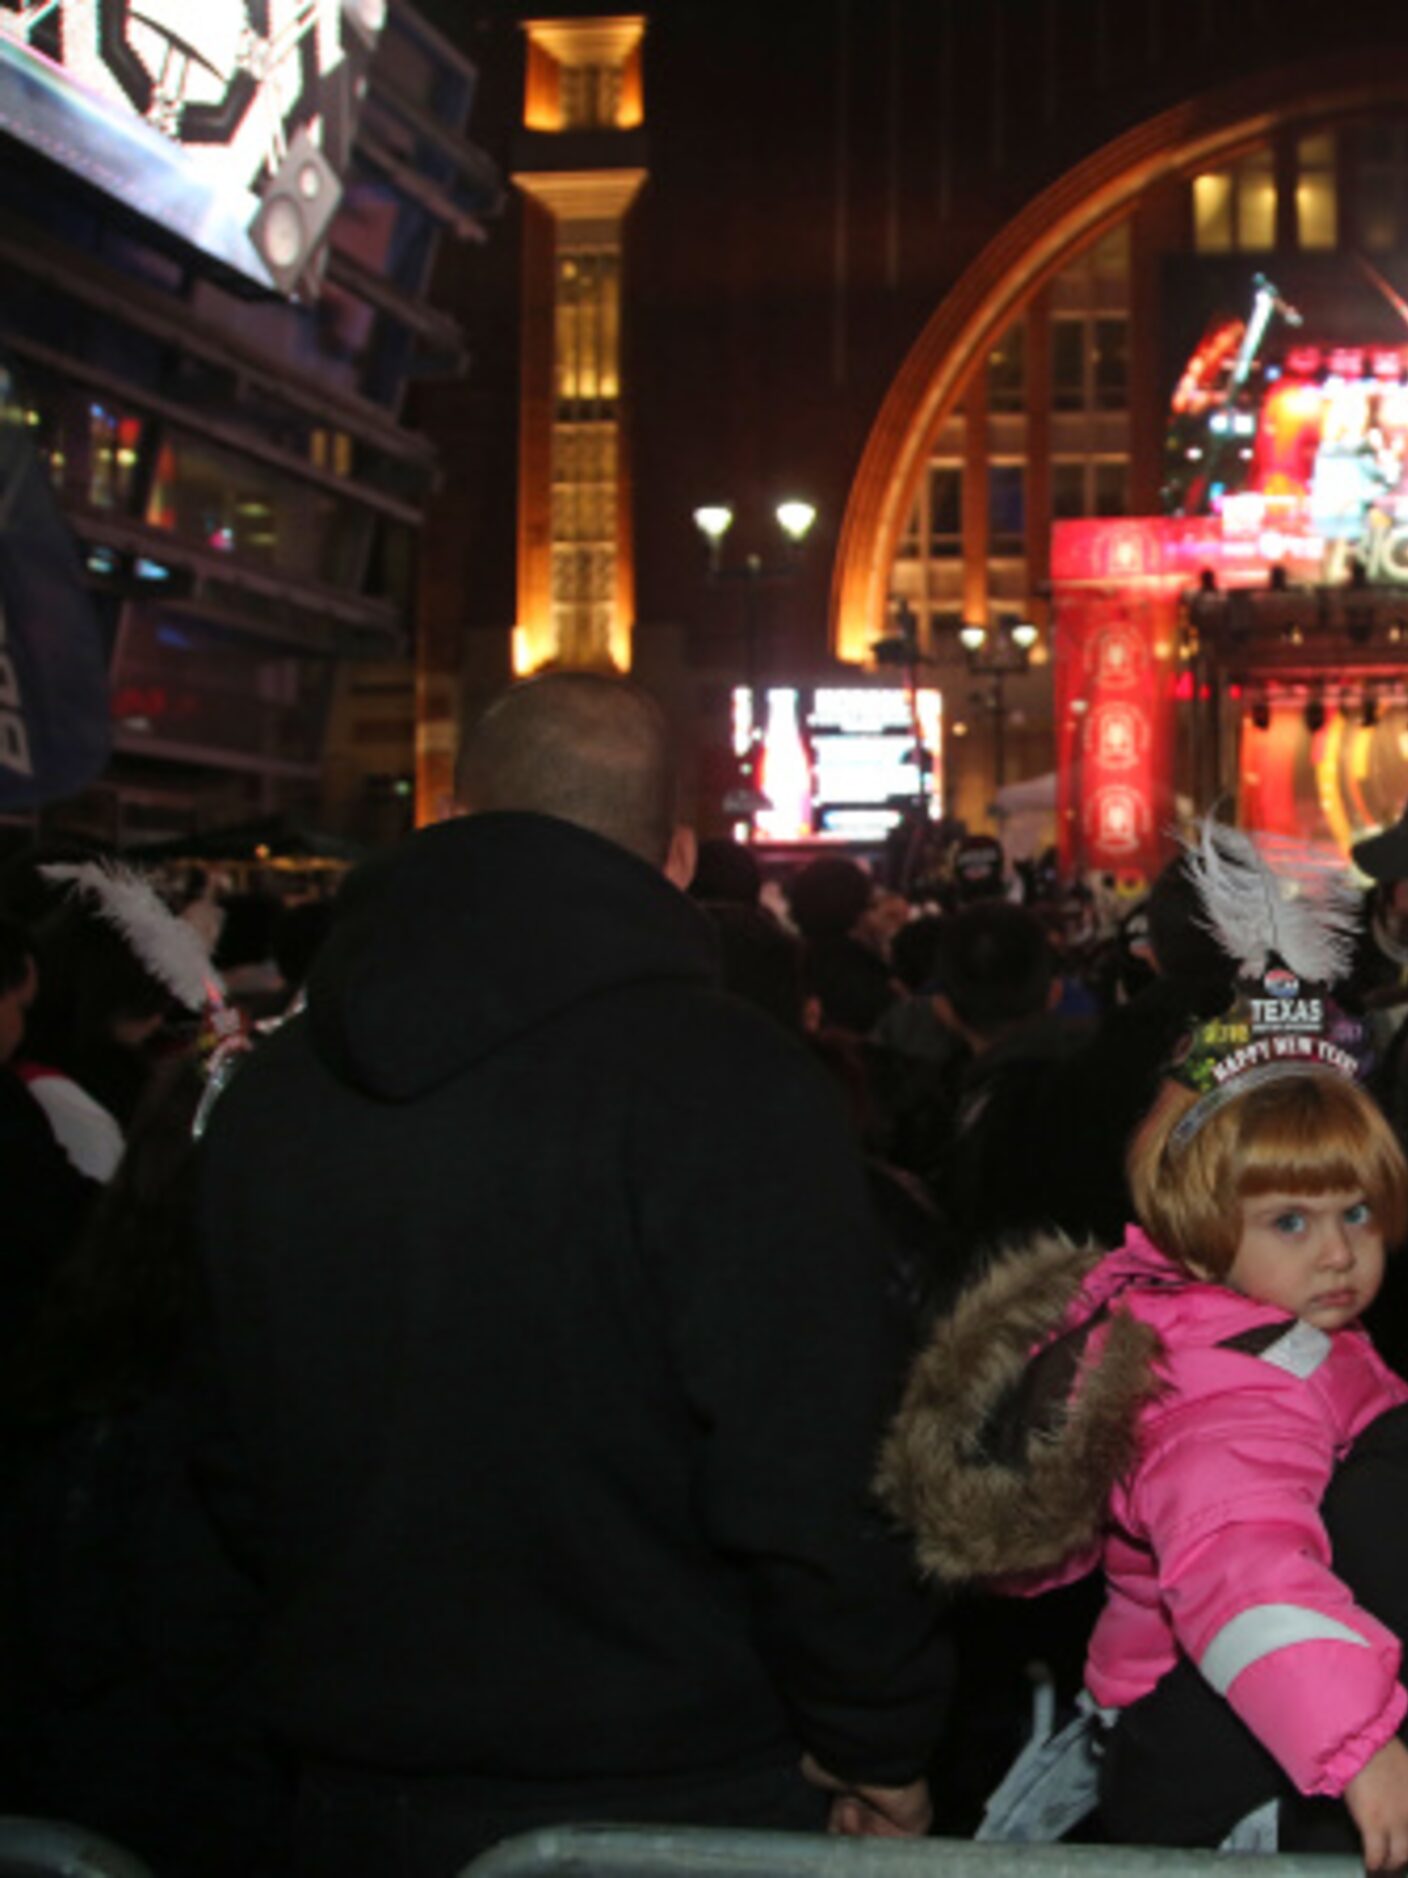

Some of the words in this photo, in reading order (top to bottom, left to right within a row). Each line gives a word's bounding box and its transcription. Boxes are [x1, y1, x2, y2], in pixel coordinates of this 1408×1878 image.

[1251, 999, 1322, 1022] TEXAS
[1212, 1038, 1270, 1082] HAPPY
[1273, 1036, 1313, 1055] NEW
